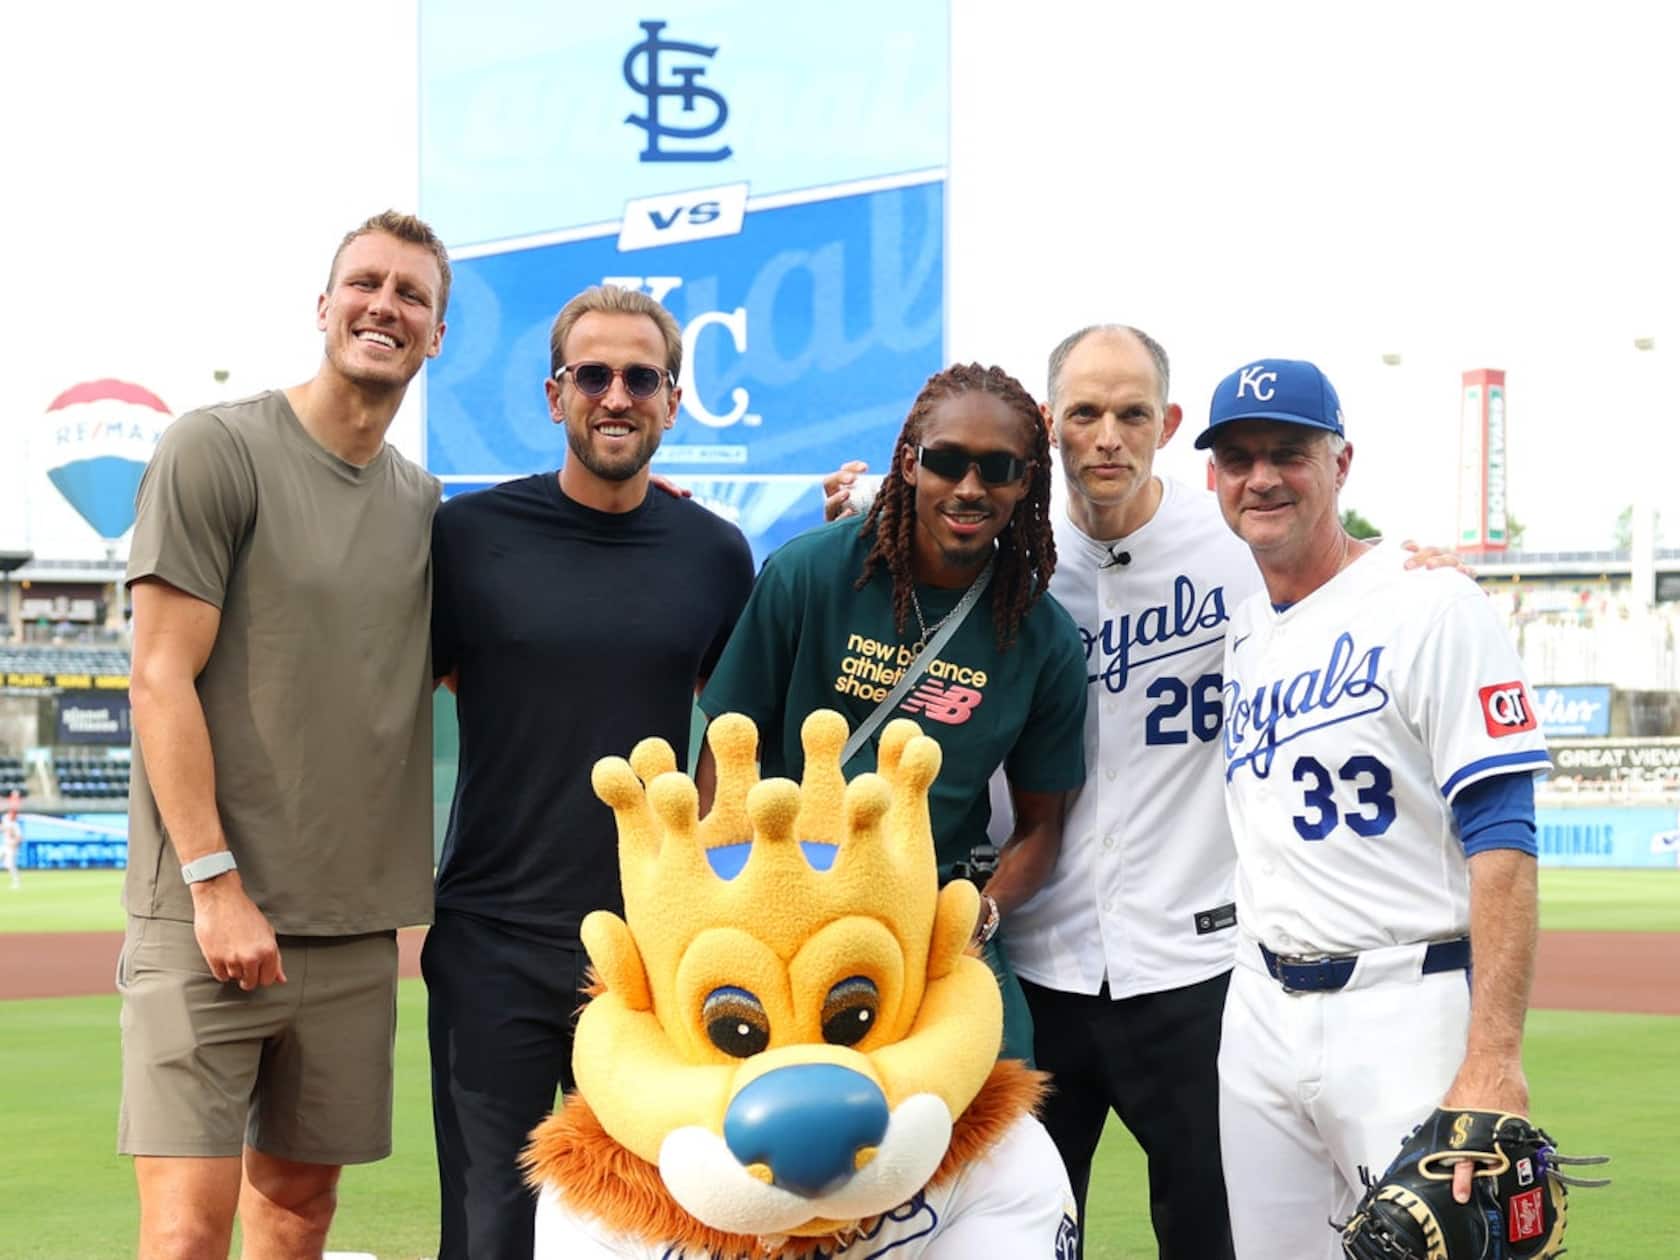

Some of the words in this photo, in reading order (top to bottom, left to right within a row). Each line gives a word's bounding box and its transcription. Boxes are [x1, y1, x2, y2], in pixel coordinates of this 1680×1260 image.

[601, 276, 750, 428] C
[1236, 365, 1278, 402] KC
[1079, 574, 1230, 693] oyals
[841, 655, 916, 690] athleti
[847, 633, 895, 663] new
[896, 643, 988, 689] bance
[834, 675, 890, 704] shoe
[1145, 672, 1224, 746] 26
[1488, 687, 1532, 729] QT
[1557, 748, 1626, 768] GREAT
[1293, 755, 1397, 841] 33
